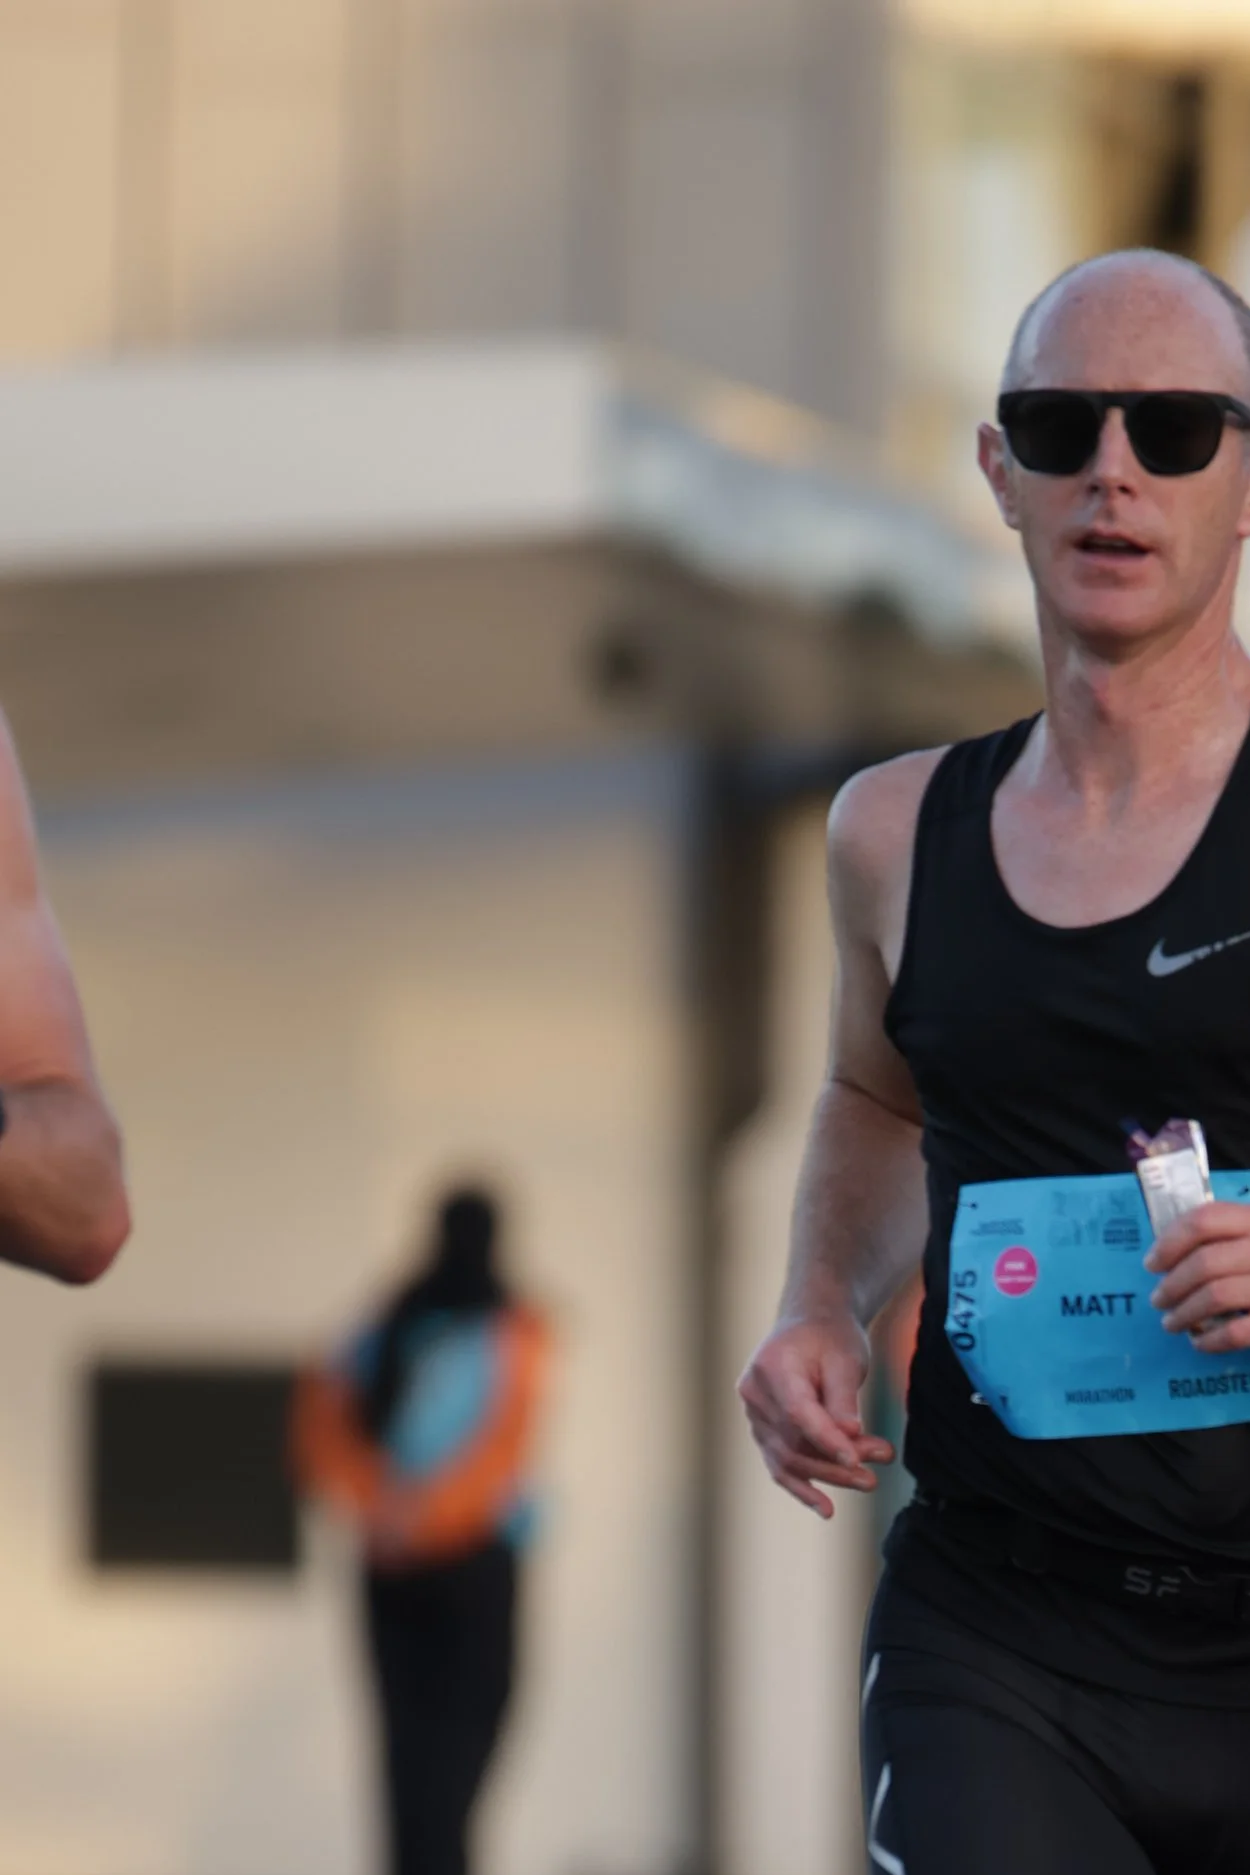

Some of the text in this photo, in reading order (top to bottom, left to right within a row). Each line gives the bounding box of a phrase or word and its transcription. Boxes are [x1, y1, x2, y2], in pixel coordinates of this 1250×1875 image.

[952, 1269, 978, 1352] 0475
[1060, 1293, 1137, 1317] MATT
[1064, 1386, 1137, 1406] MARATHON
